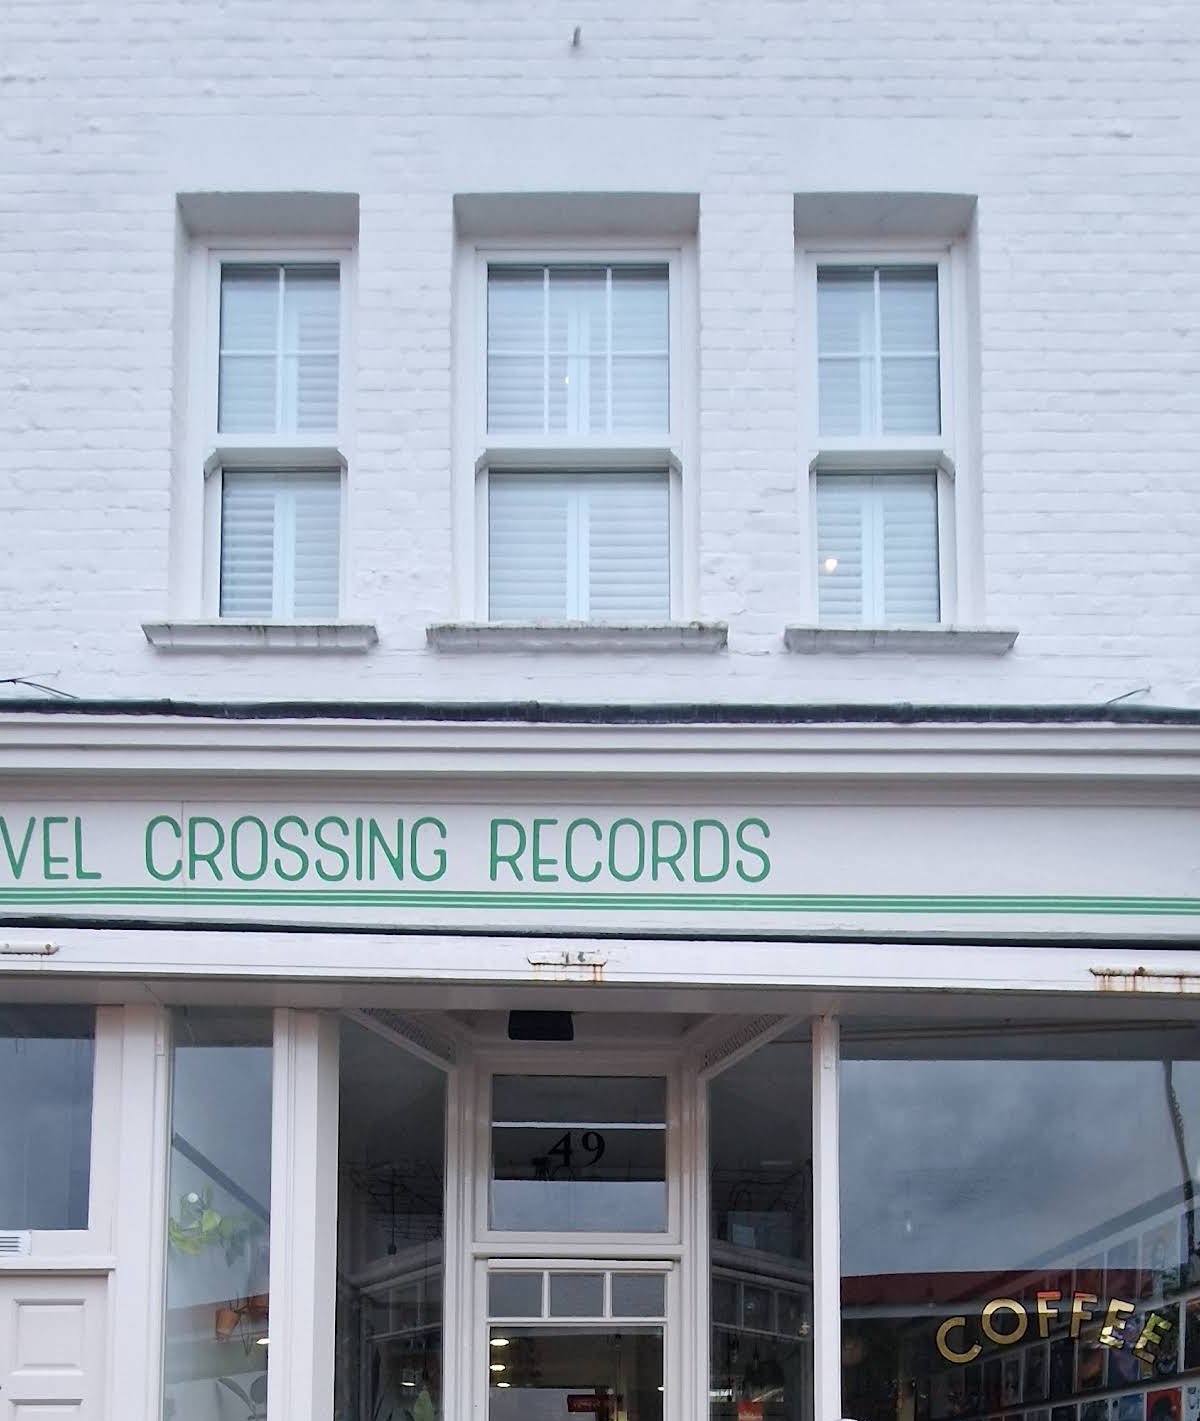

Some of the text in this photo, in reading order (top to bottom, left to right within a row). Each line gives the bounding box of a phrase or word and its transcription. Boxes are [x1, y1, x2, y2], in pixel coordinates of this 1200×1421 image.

[0, 815, 770, 883] VEL CROSSING RECORDS
[547, 1131, 605, 1167] 49
[935, 1290, 1173, 1365] COFFEE
